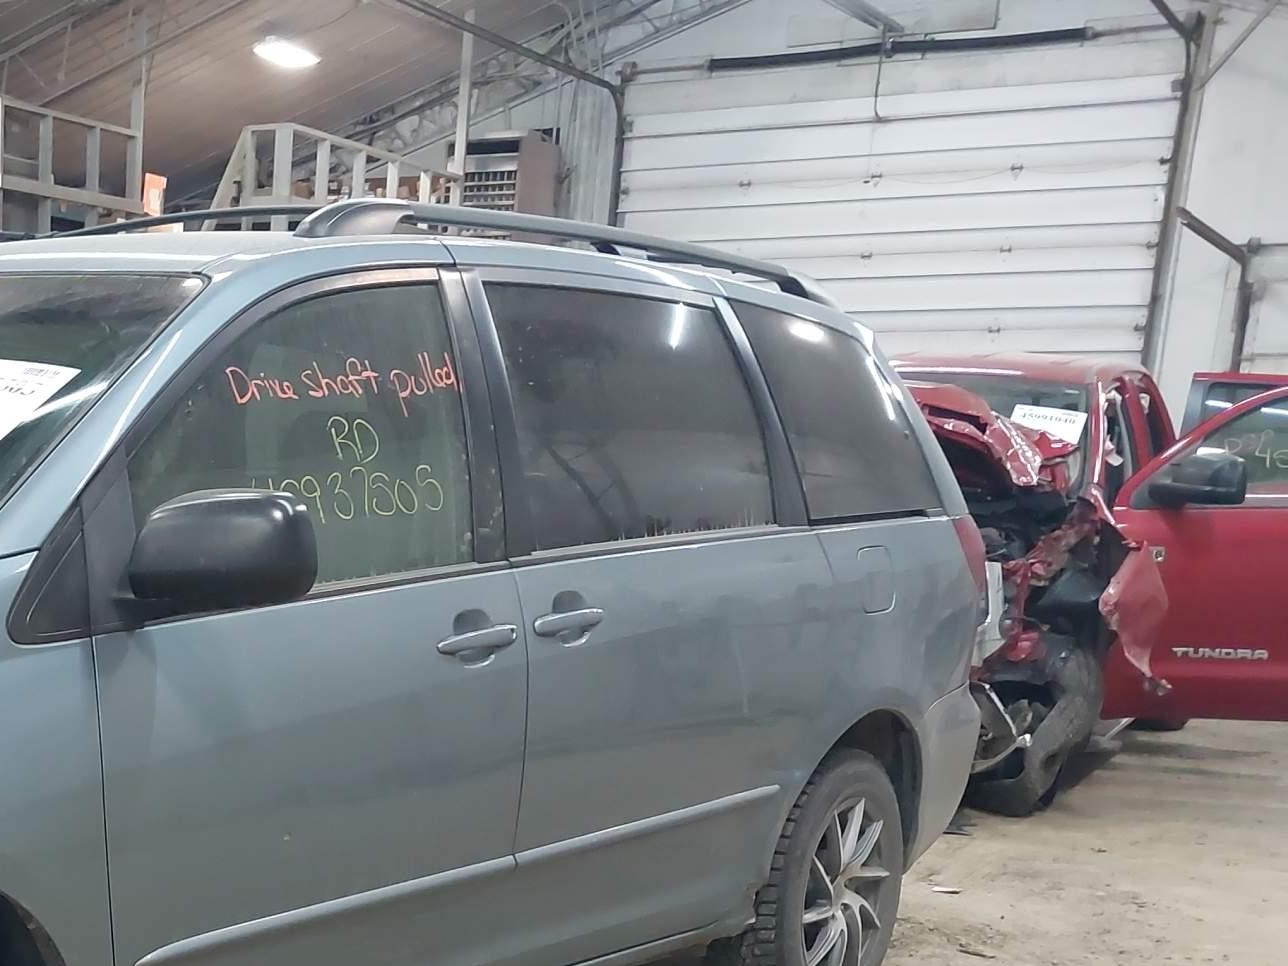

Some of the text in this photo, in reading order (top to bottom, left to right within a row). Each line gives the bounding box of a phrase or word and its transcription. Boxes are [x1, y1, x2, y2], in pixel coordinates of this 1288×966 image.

[225, 366, 299, 405] Drive
[390, 351, 463, 417] pulled
[326, 416, 380, 464] RD
[1171, 647, 1269, 661] TUNDRA
